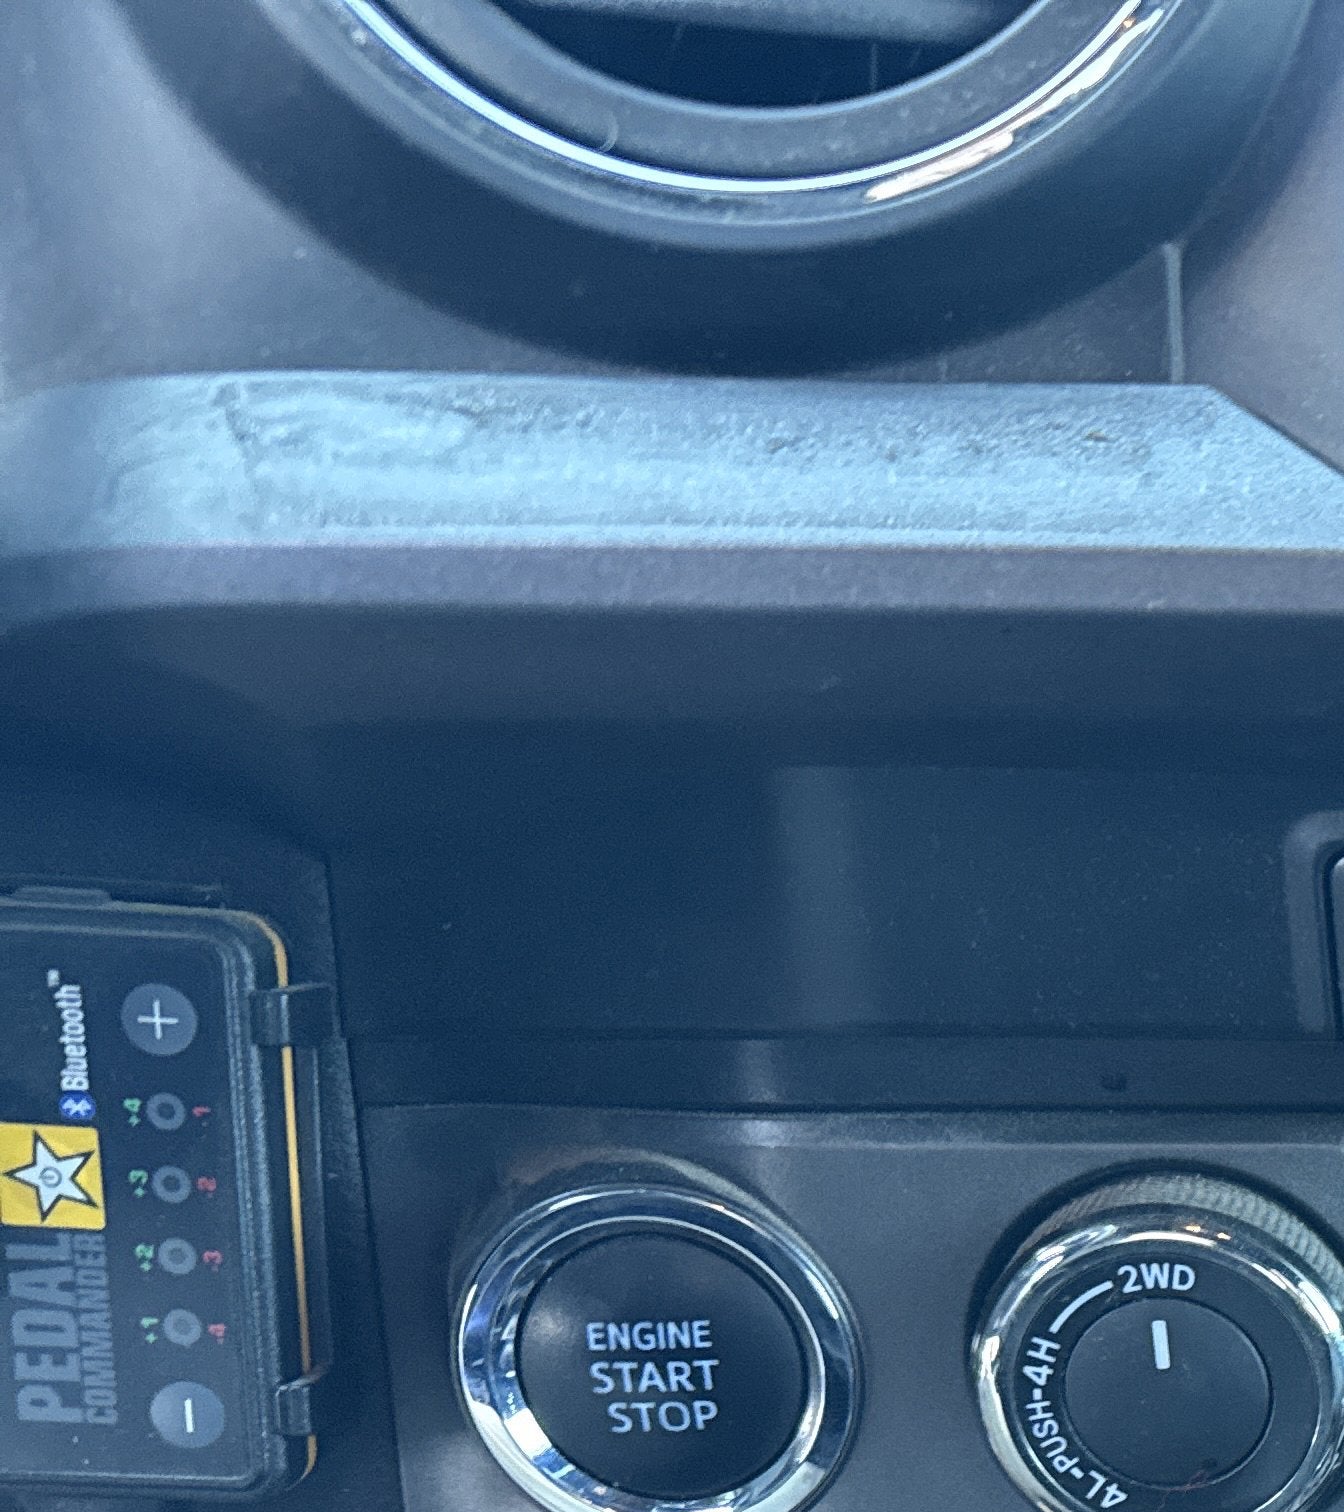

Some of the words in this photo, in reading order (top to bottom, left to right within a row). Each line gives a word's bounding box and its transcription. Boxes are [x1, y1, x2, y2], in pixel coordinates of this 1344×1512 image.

[1116, 1262, 1197, 1294] 2WD
[5, 1233, 85, 1422] PEDAL
[73, 1234, 119, 1425] COMMANDER
[586, 1320, 713, 1351] ENGINE
[589, 1358, 720, 1395] START
[606, 1399, 719, 1434] STOP
